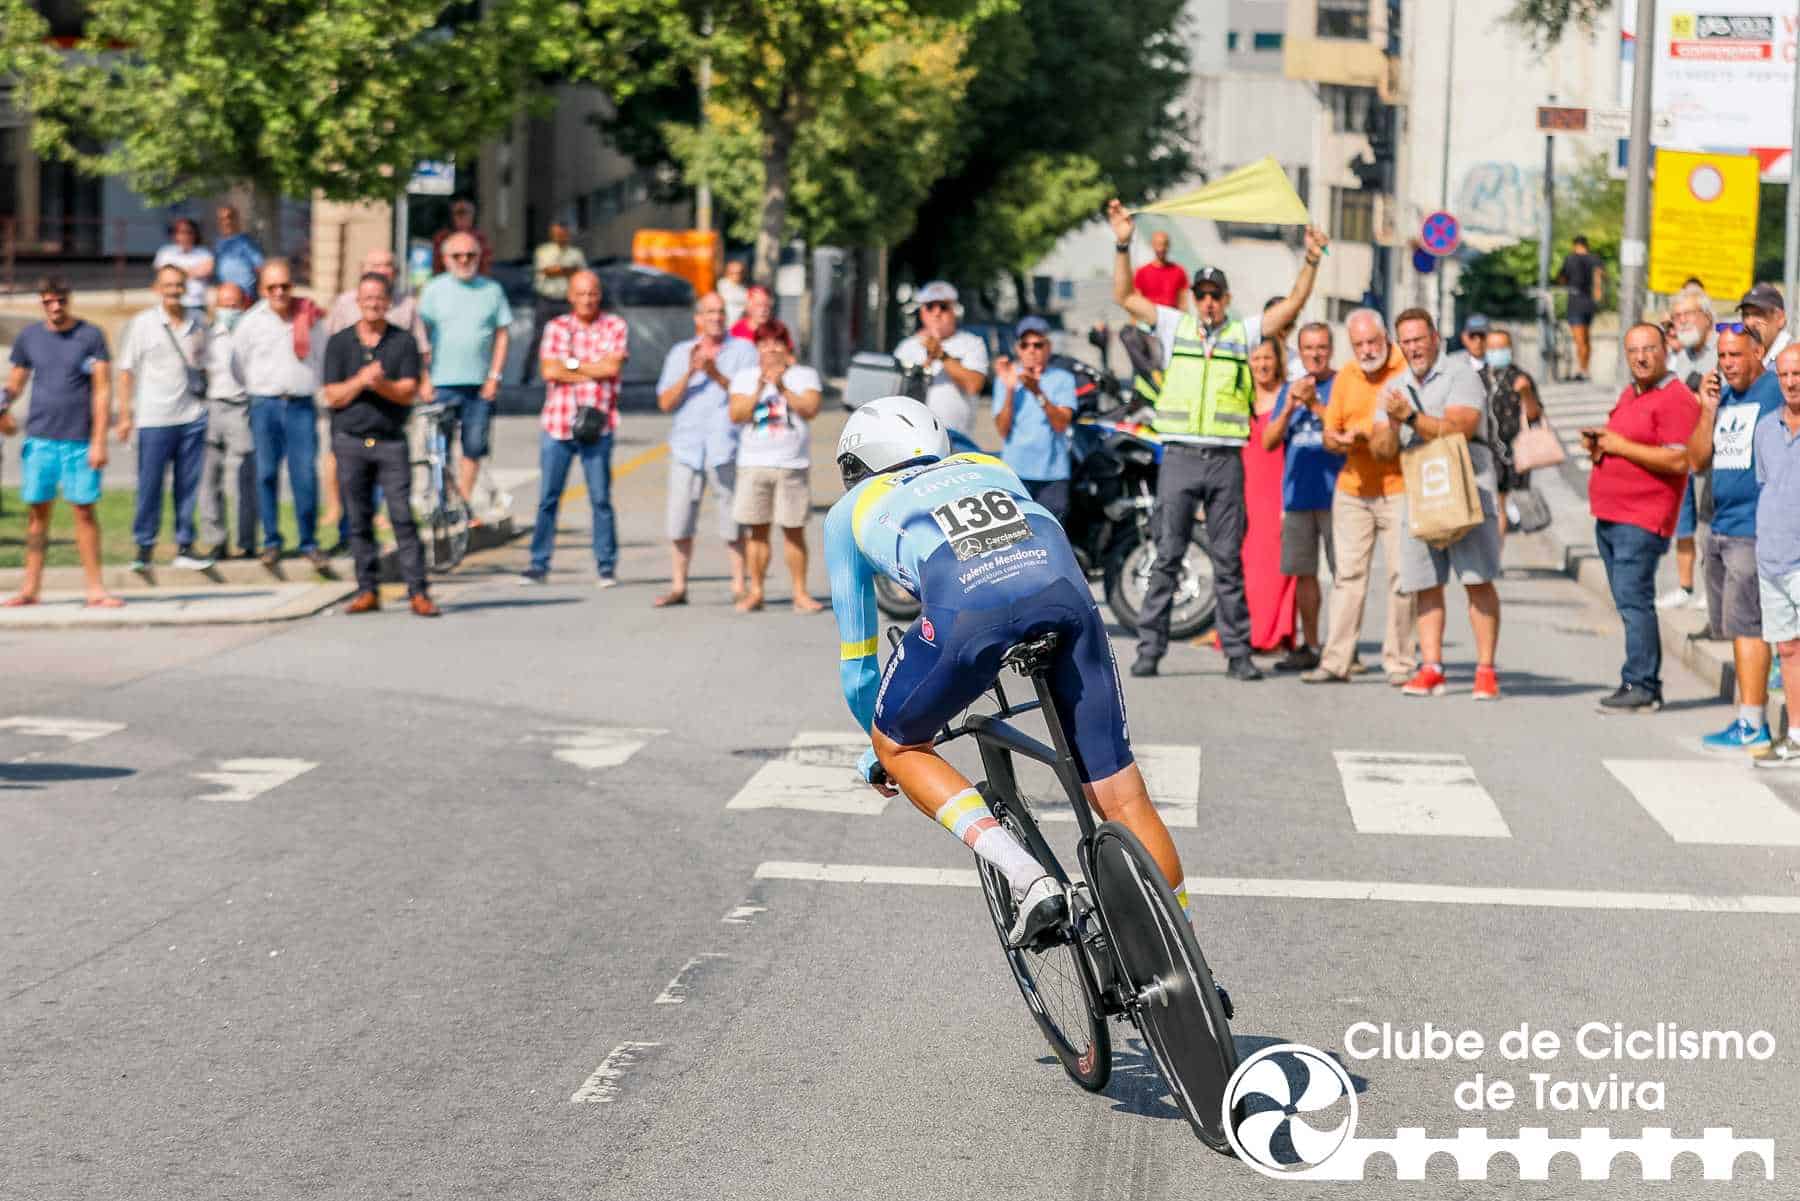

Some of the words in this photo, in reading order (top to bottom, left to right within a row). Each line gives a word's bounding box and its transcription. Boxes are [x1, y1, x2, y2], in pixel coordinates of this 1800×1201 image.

[934, 490, 1018, 536] 136
[959, 561, 996, 585] Valente
[994, 549, 1048, 567] Mendonça
